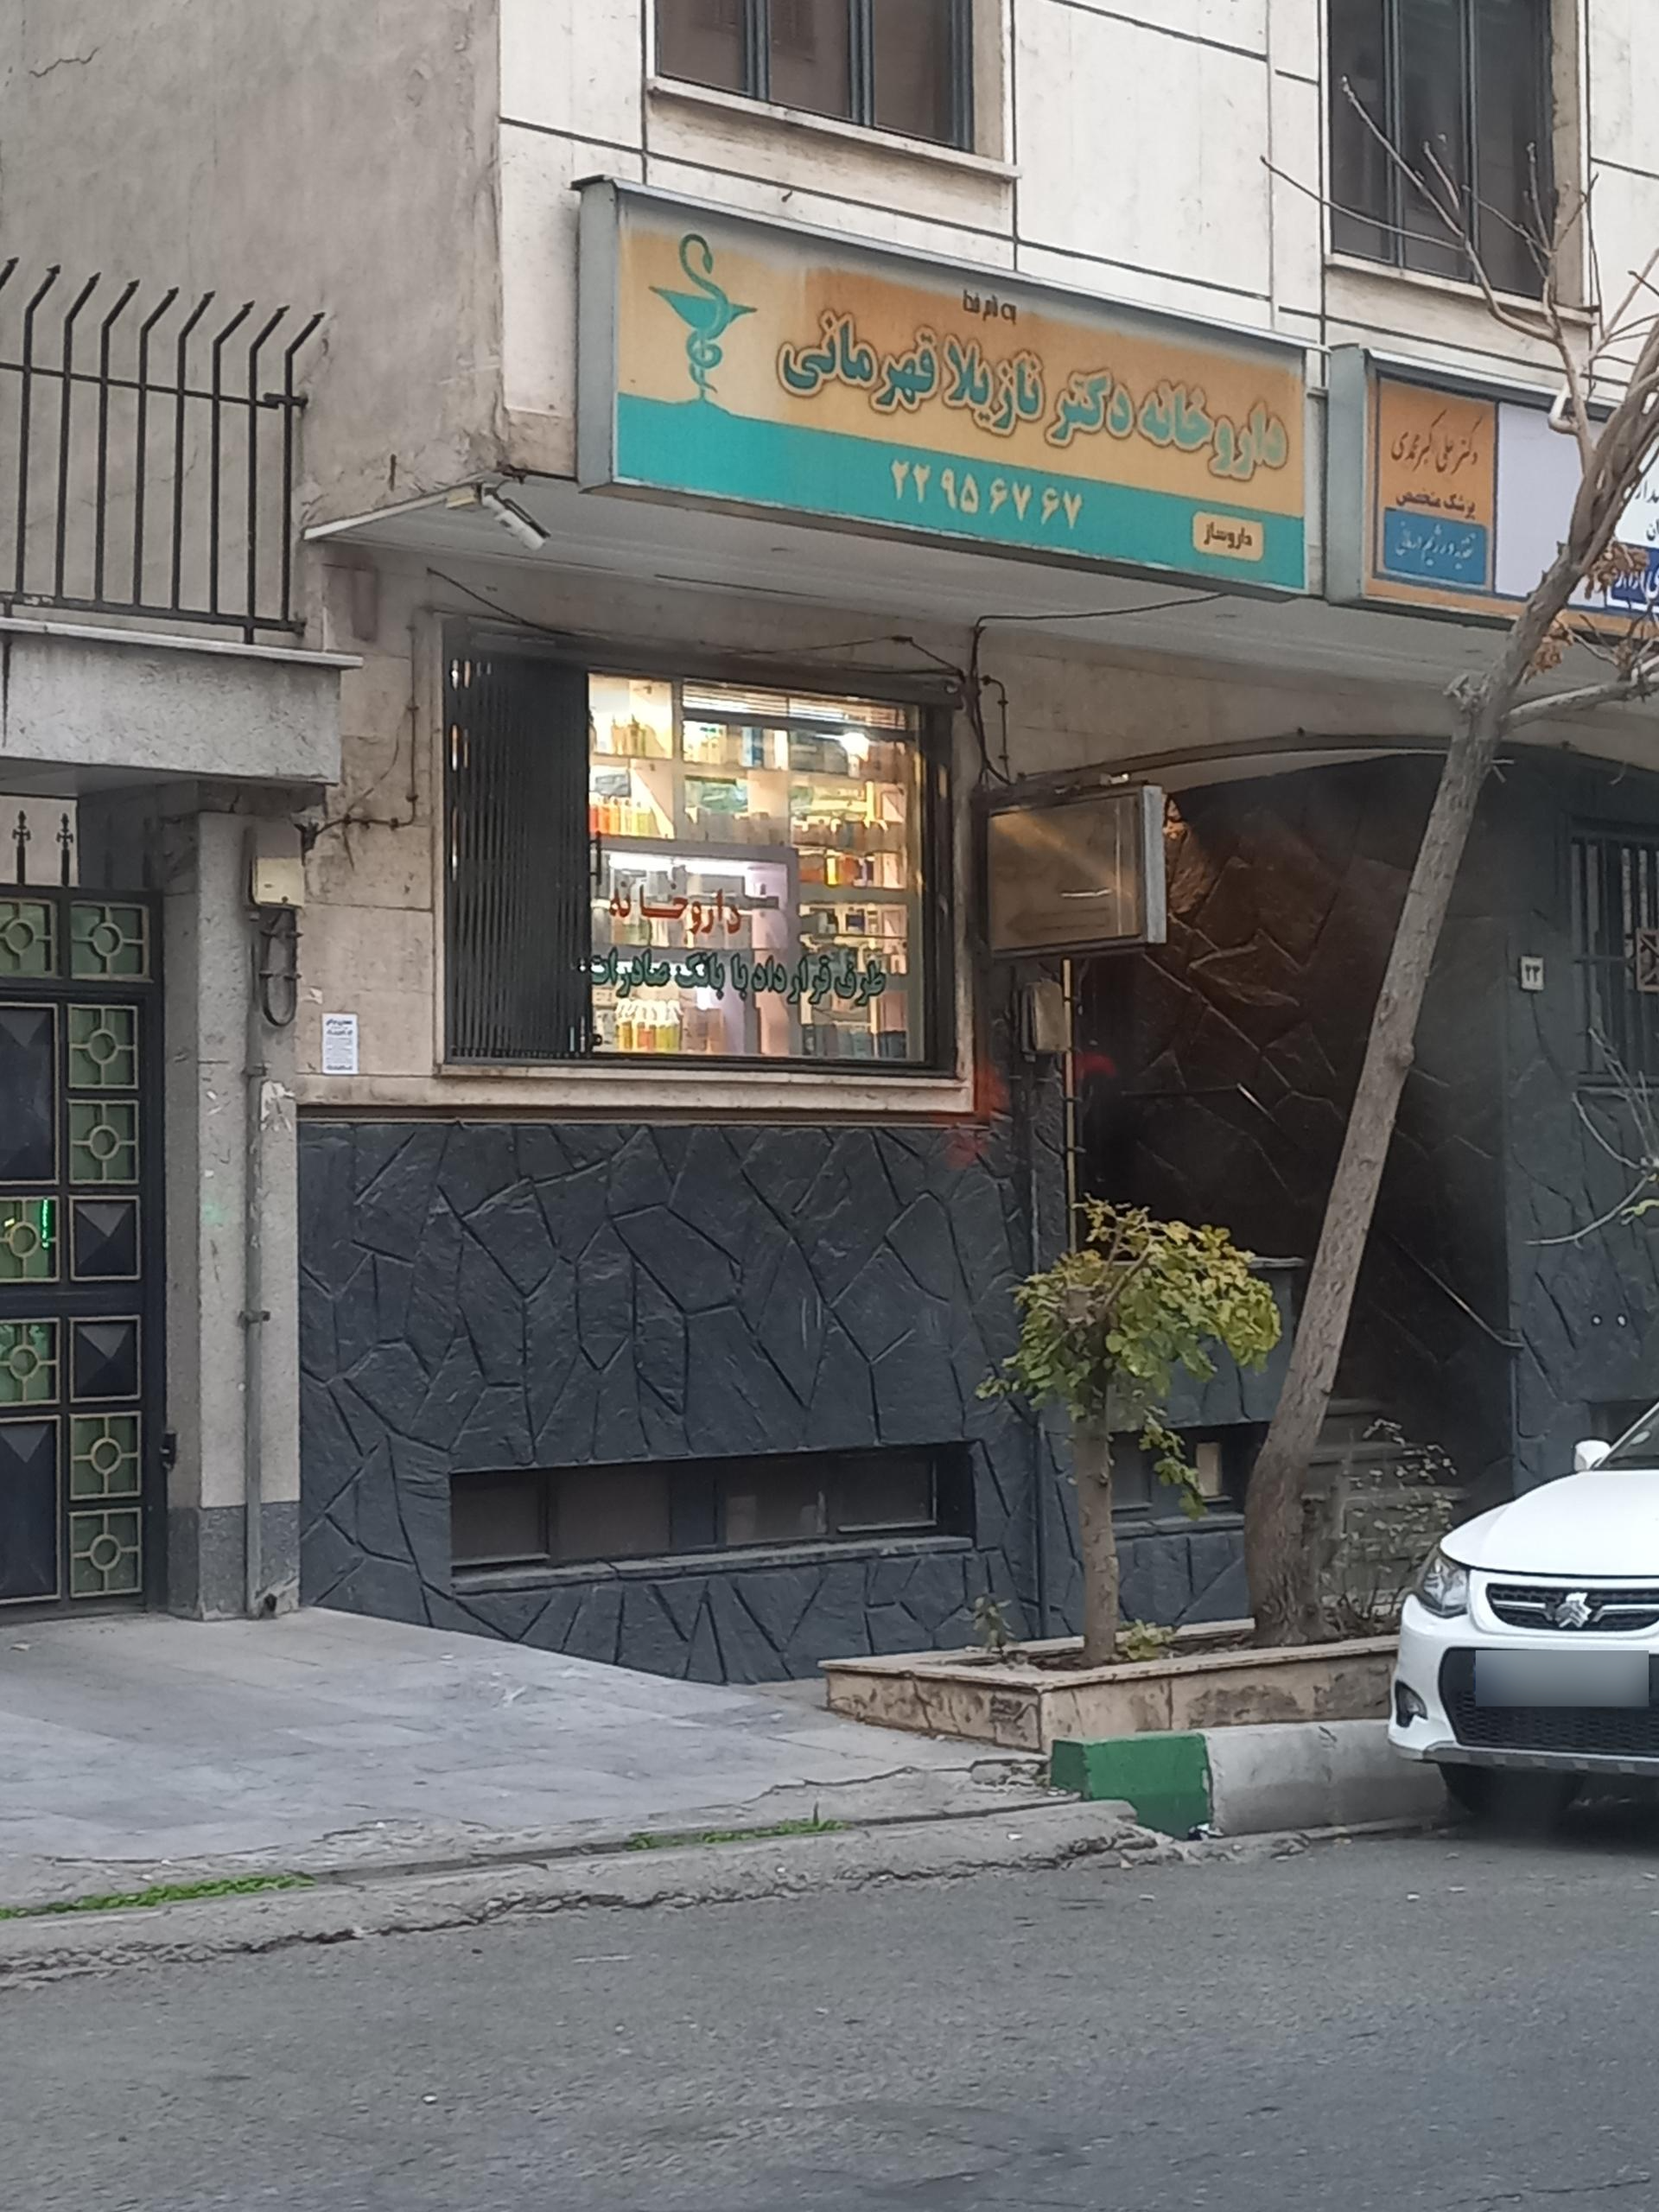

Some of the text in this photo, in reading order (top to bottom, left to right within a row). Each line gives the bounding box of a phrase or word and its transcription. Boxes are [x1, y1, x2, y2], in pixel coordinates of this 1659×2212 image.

[778, 308, 1288, 481] داروخانه دکتر نازیلا قهرمانی
[1451, 415, 1483, 475] دکتر
[1443, 493, 1476, 520] پزشک
[1204, 521, 1252, 550] داروساز
[608, 880, 741, 934] داروخانه
[590, 946, 671, 999] صادرات
[676, 951, 725, 1000] بانک
[731, 952, 748, 1001] با
[835, 960, 886, 1007] طرف
